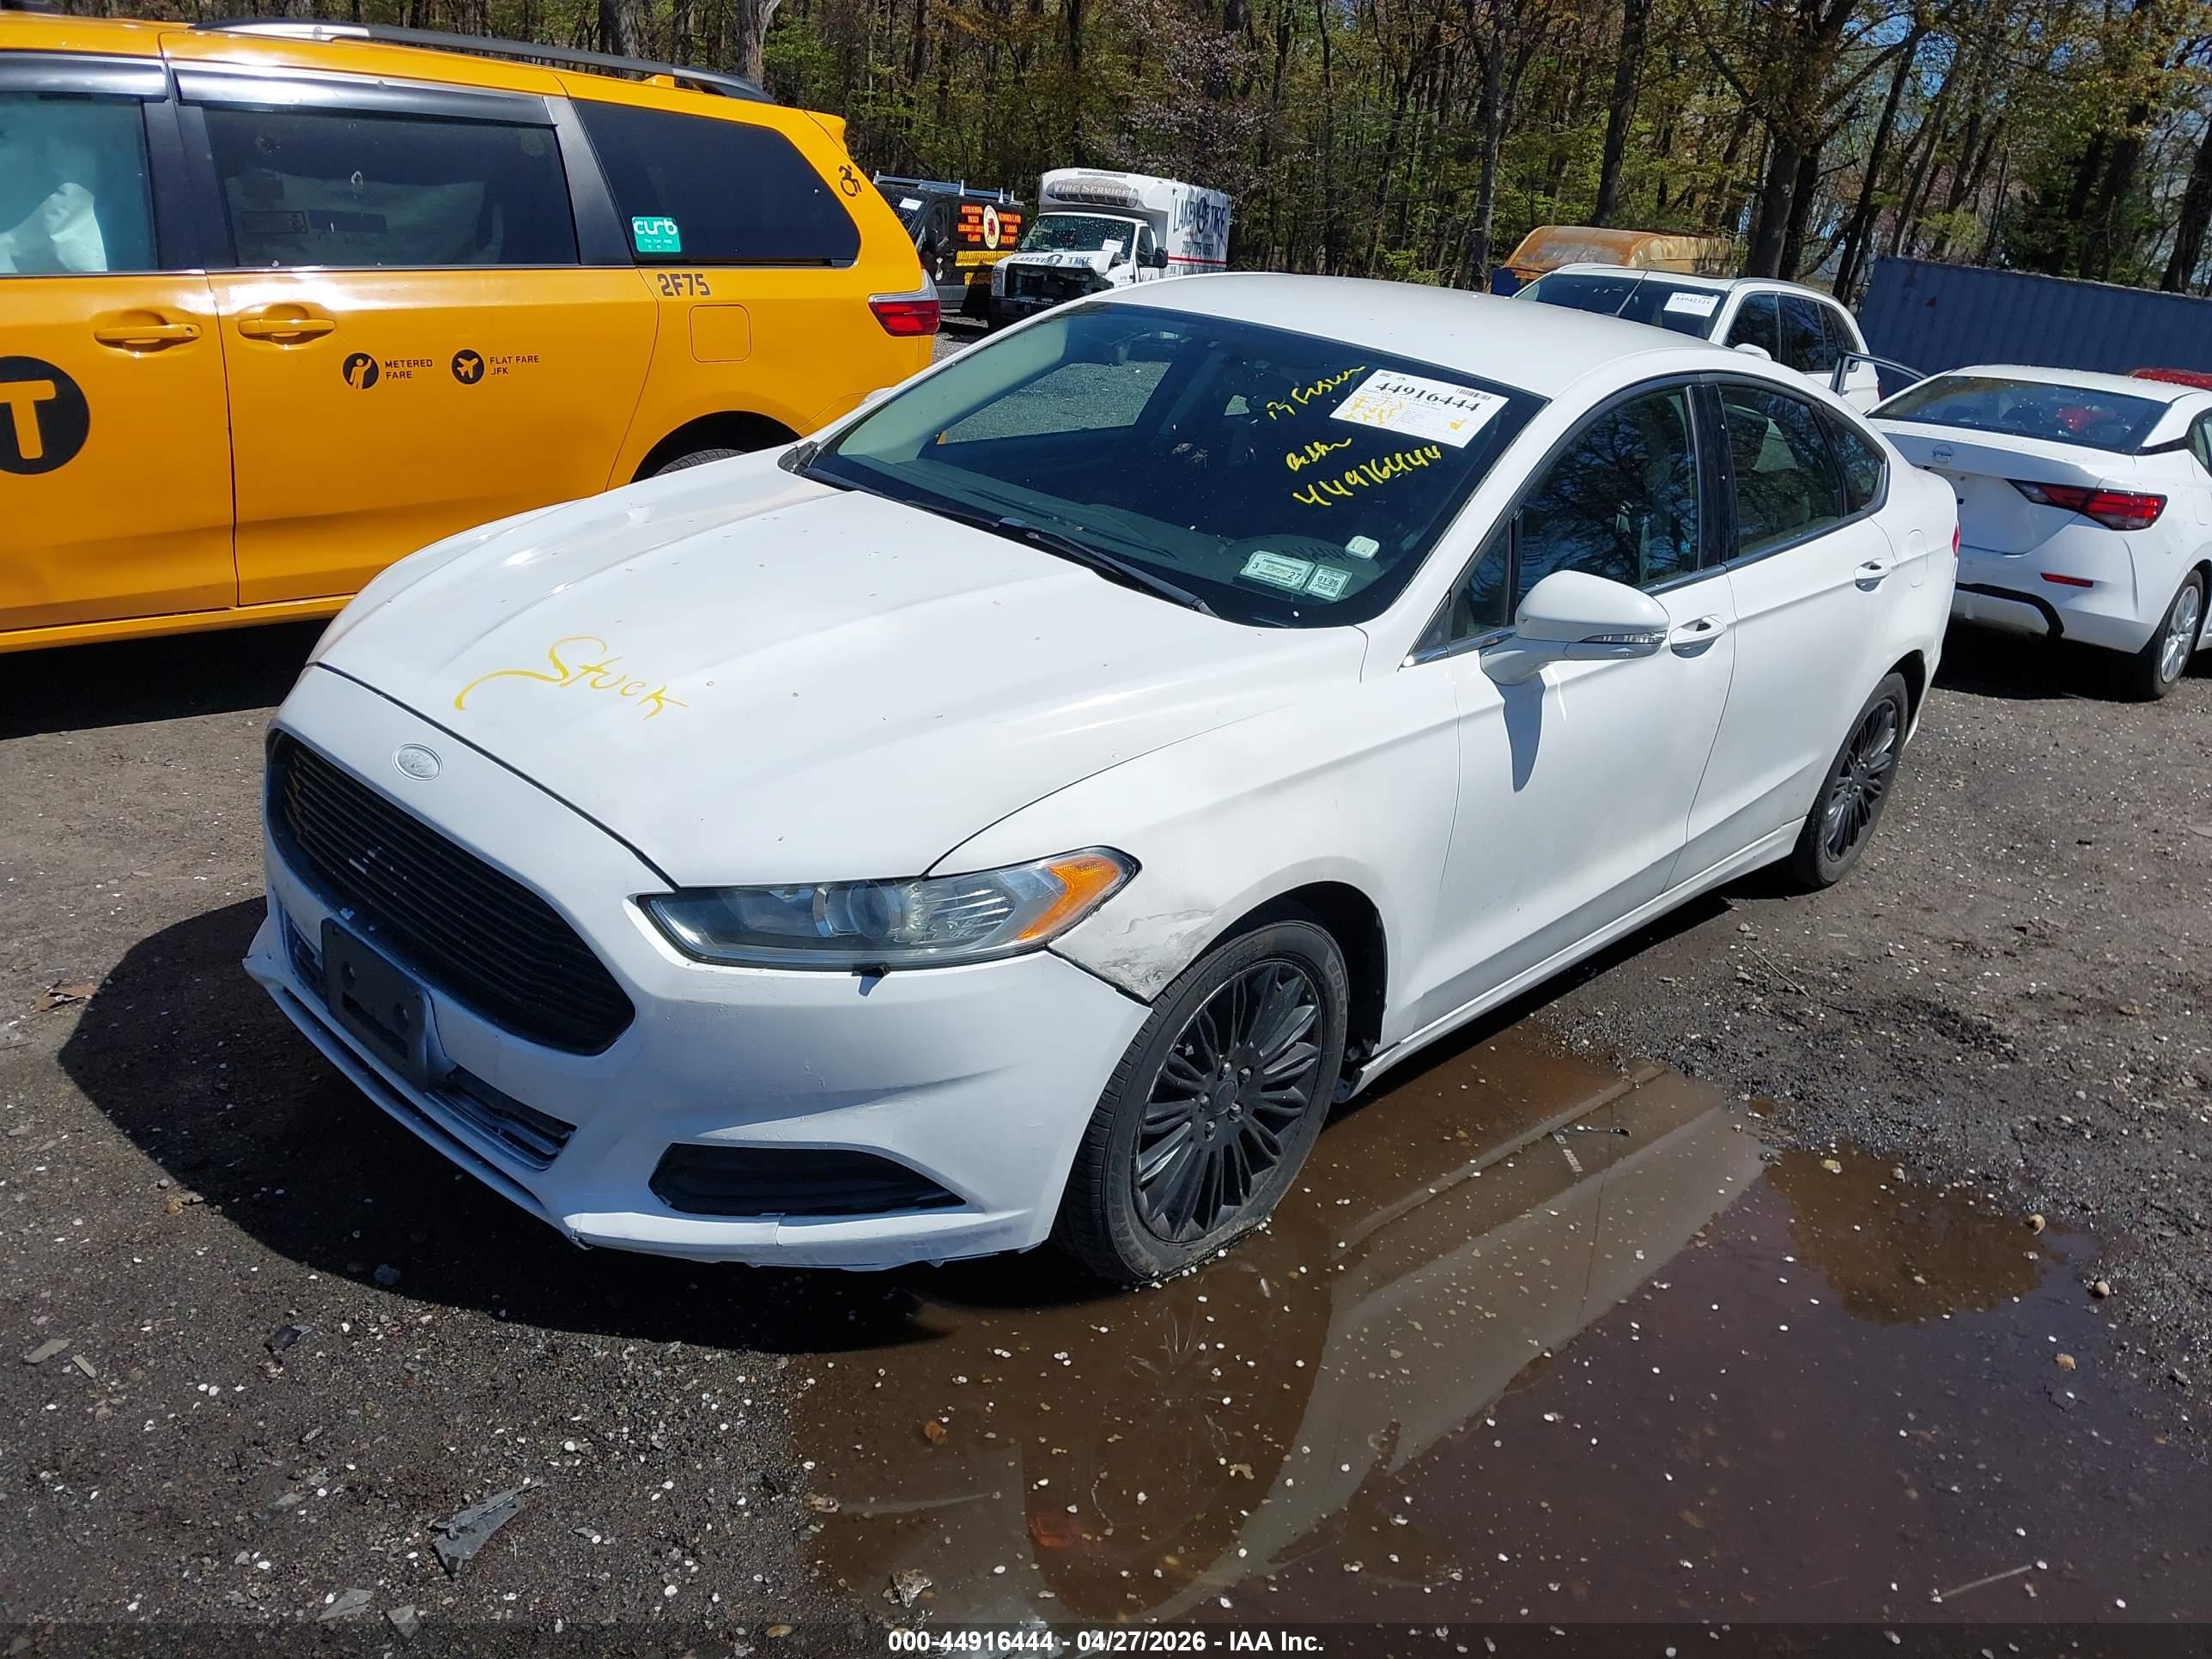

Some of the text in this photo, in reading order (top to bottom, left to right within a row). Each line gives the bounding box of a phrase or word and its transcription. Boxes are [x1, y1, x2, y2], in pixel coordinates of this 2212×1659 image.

[1056, 184, 1129, 198] TIRE SERVICE
[634, 218, 678, 236] curb
[1211, 204, 1225, 239] TIRE
[1067, 257, 1093, 266] TIRE
[657, 273, 711, 297] 2F75
[384, 358, 434, 369] METERED
[489, 355, 540, 366] FLAT FARE
[386, 370, 413, 380] FARE
[490, 367, 509, 376] JFK
[1375, 381, 1482, 412] 44916444
[0, 379, 57, 460] T
[1291, 444, 1443, 507] 44916444
[1252, 562, 1261, 570] 3
[1288, 571, 1303, 581] 27
